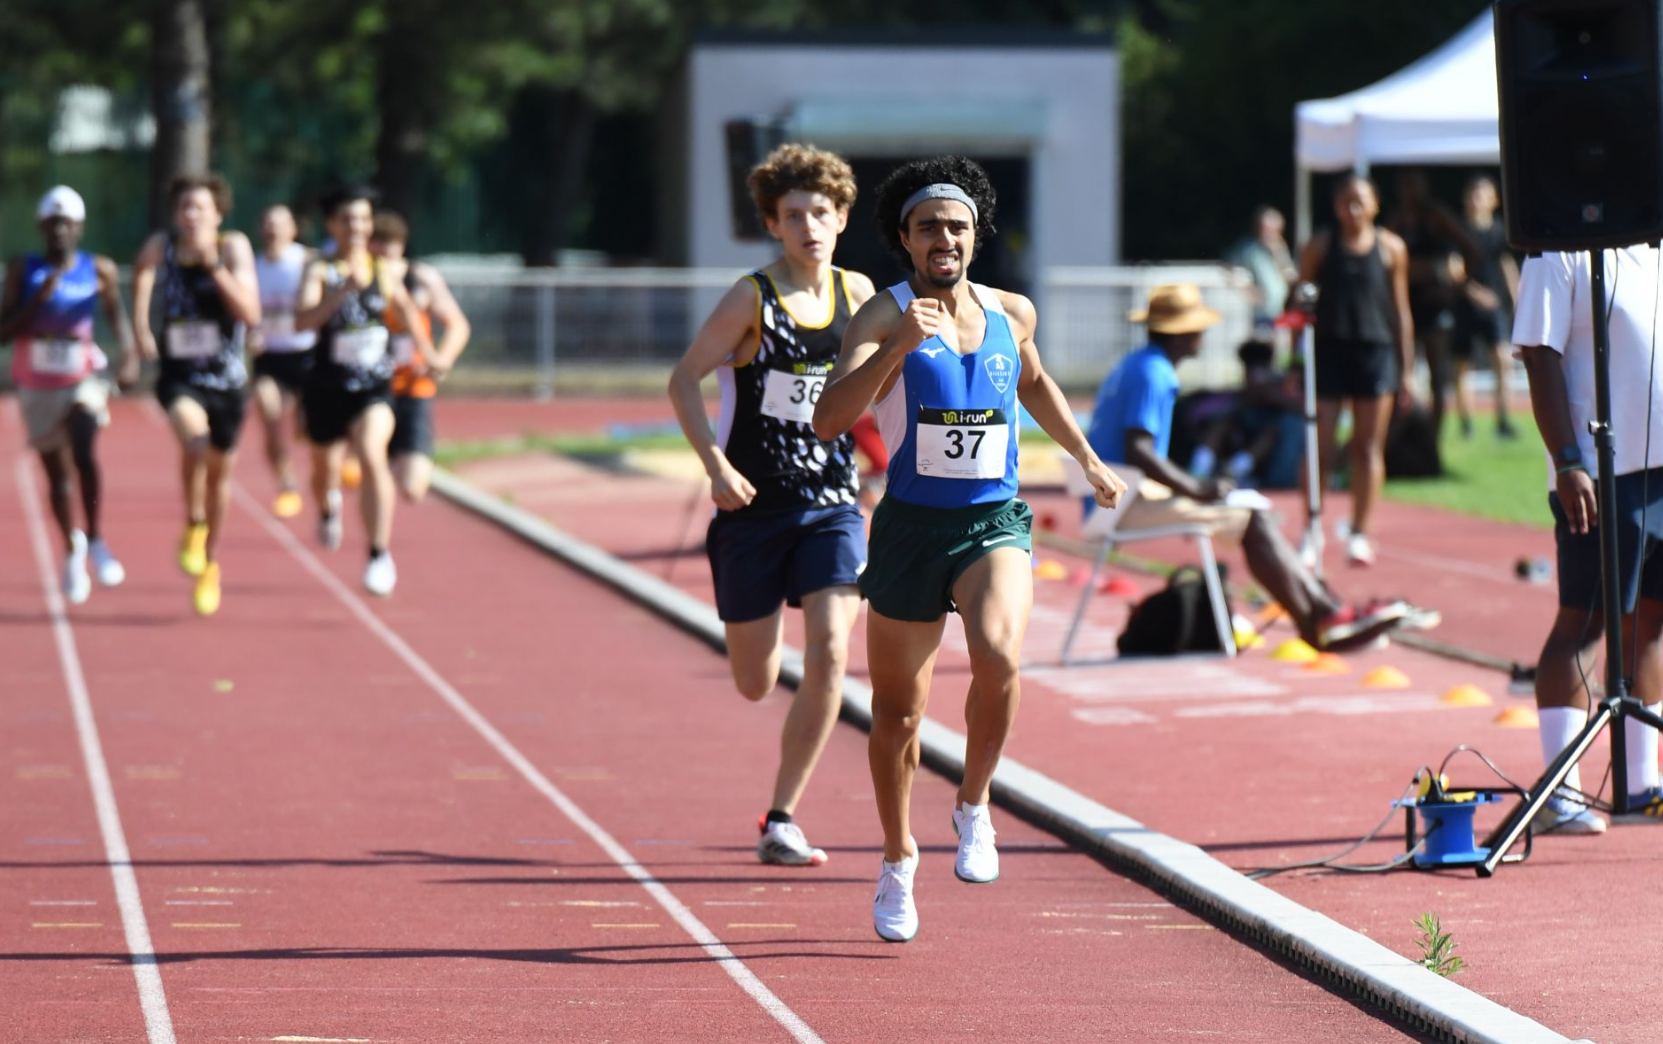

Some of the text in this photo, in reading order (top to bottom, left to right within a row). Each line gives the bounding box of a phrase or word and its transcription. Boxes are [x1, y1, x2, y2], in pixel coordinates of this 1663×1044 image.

[807, 364, 828, 375] i-run
[790, 379, 824, 405] 36
[960, 411, 987, 424] i-run
[944, 429, 986, 460] 37
